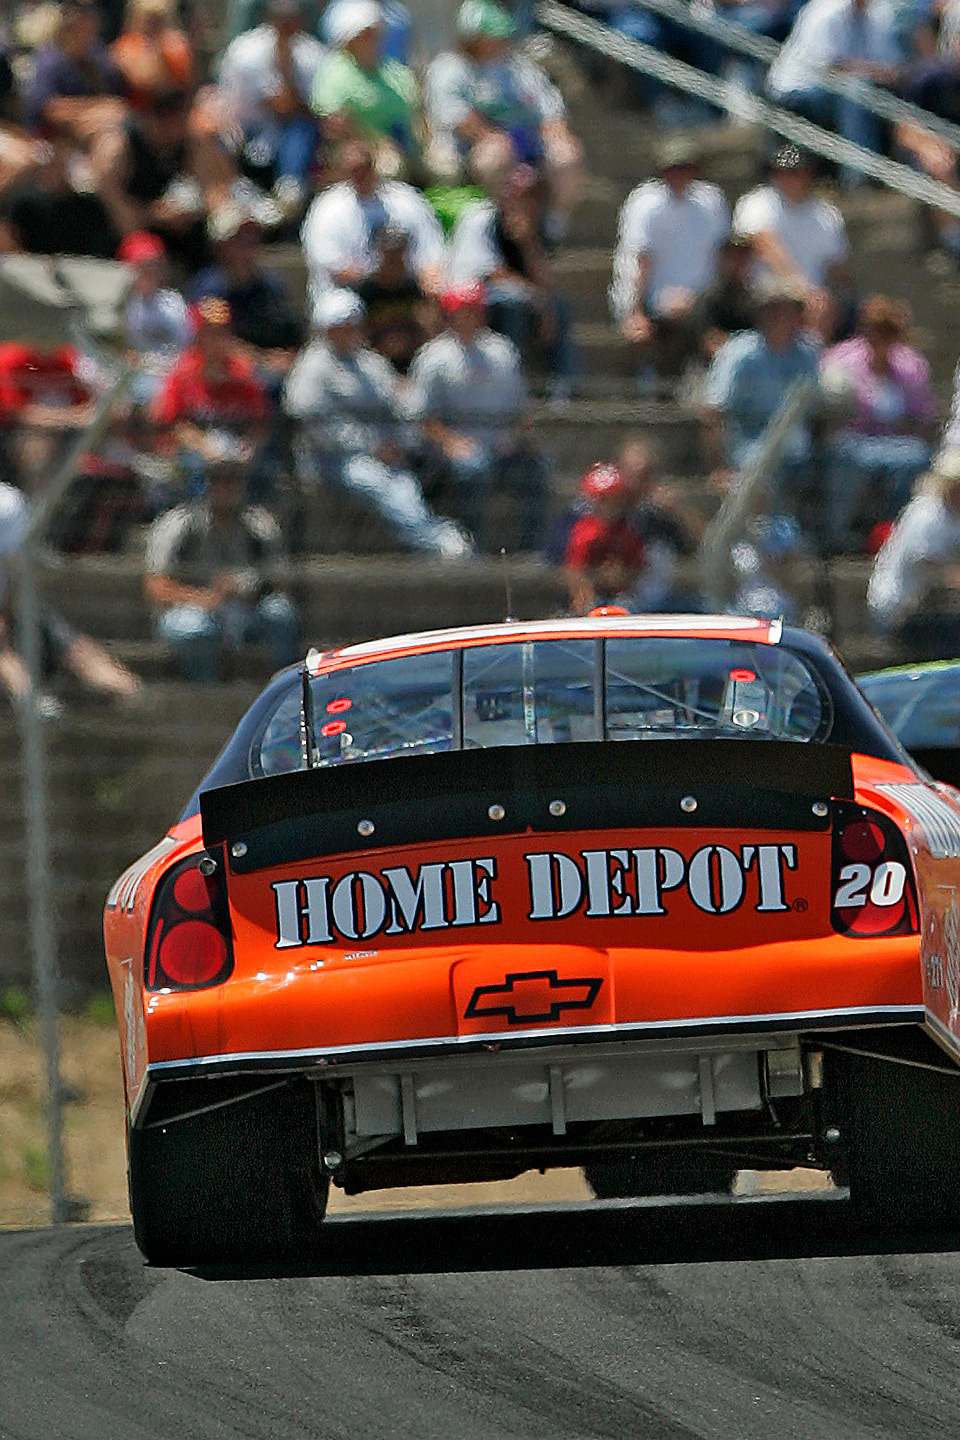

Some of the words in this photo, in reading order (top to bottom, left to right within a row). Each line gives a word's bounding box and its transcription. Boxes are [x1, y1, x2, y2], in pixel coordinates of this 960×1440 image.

[271, 856, 500, 949] HOME
[524, 843, 797, 921] DEPOT
[833, 861, 907, 907] 20
